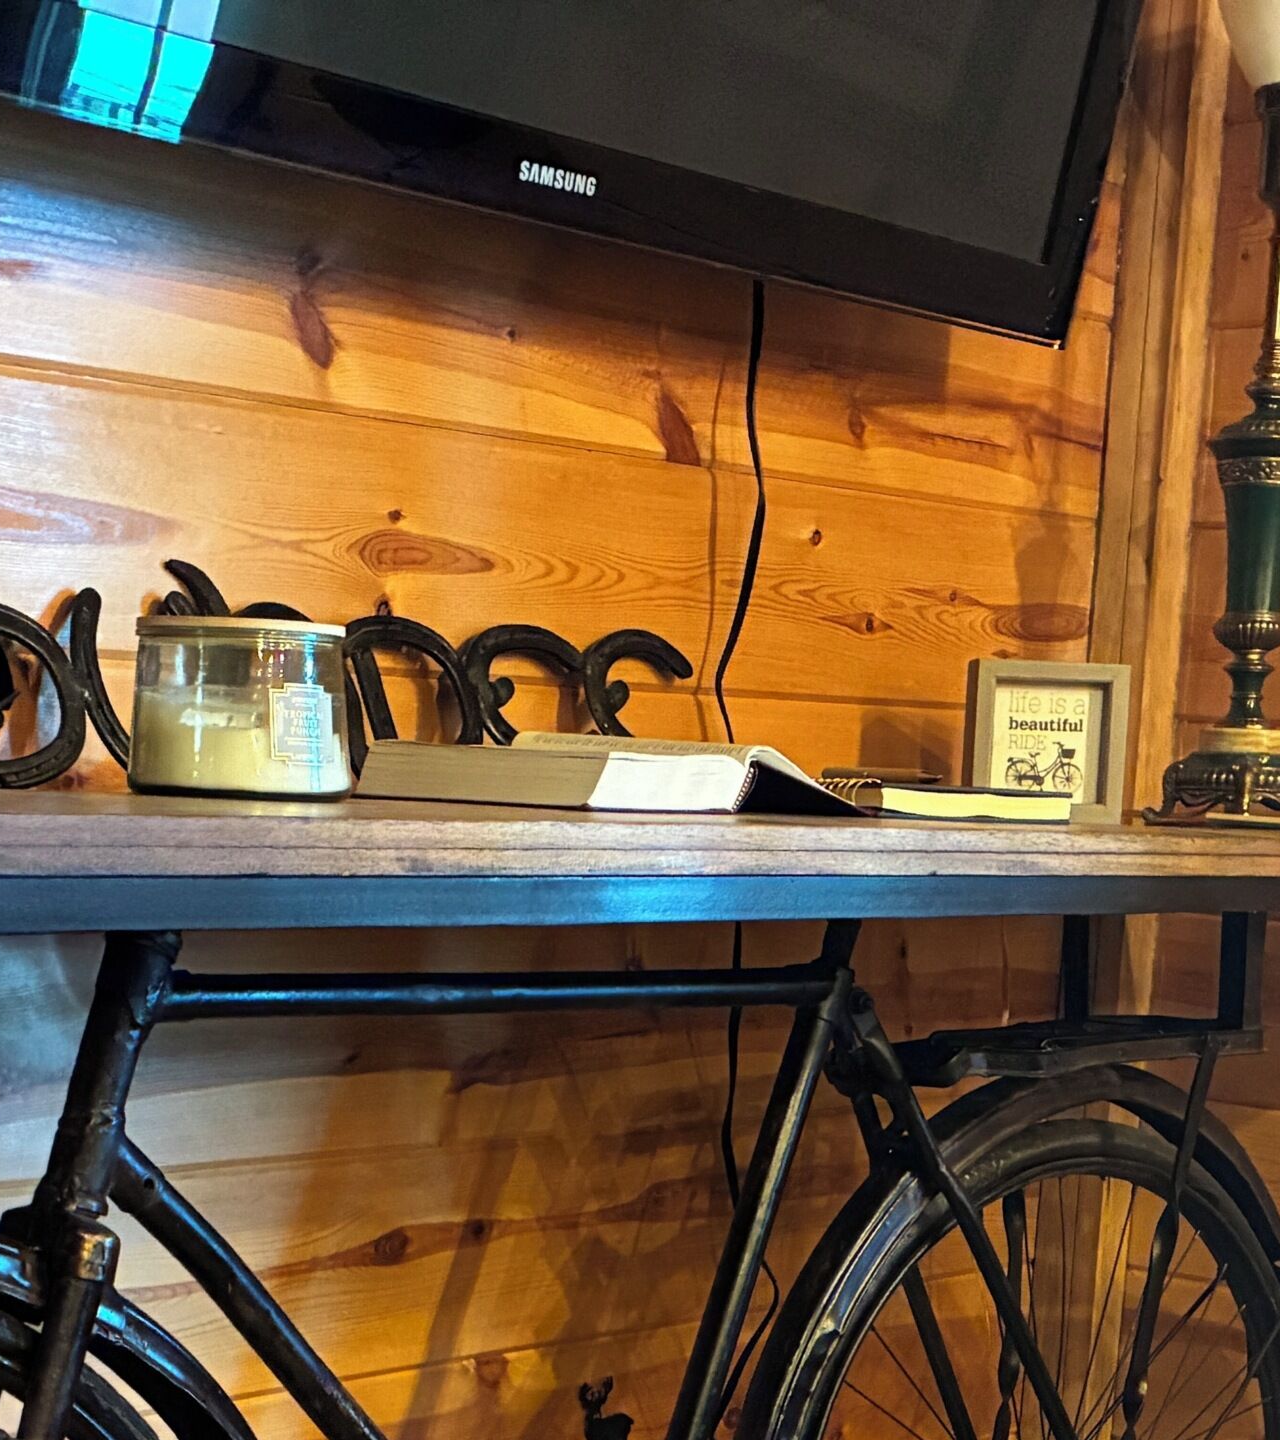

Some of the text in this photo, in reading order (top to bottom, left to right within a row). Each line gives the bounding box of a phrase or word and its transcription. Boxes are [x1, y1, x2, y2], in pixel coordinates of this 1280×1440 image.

[519, 160, 597, 196] SAMSUNG
[1008, 690, 1086, 715] life is a
[1008, 716, 1083, 732] beautiful
[1008, 734, 1047, 751] RIDE
